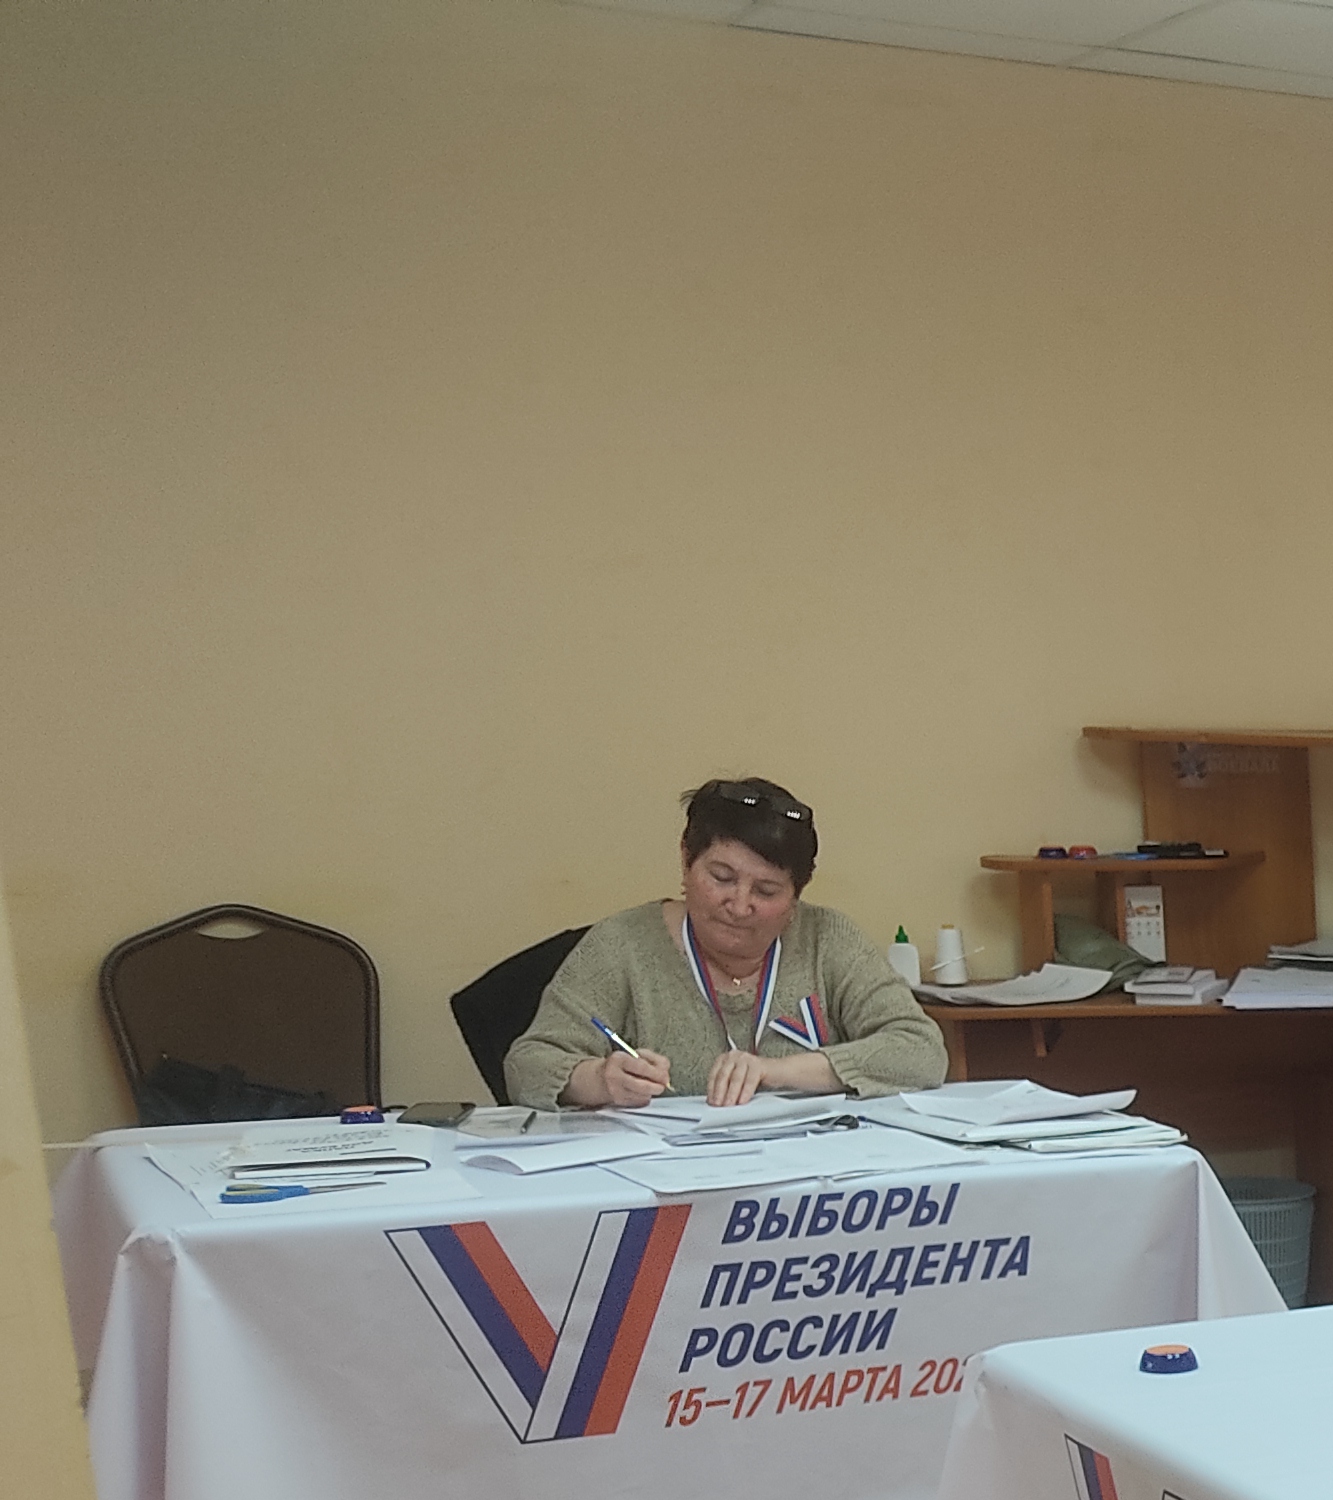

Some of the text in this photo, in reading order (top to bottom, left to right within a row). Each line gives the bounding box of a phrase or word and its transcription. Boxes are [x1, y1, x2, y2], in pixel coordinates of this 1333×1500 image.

[721, 1183, 961, 1245] ВЫБОРЫ
[700, 1236, 1032, 1309] ПРЕЗИДЕНТА
[679, 1308, 899, 1374] РОССИИ
[776, 1364, 904, 1415] МАРТА
[910, 1353, 974, 1397] 20
